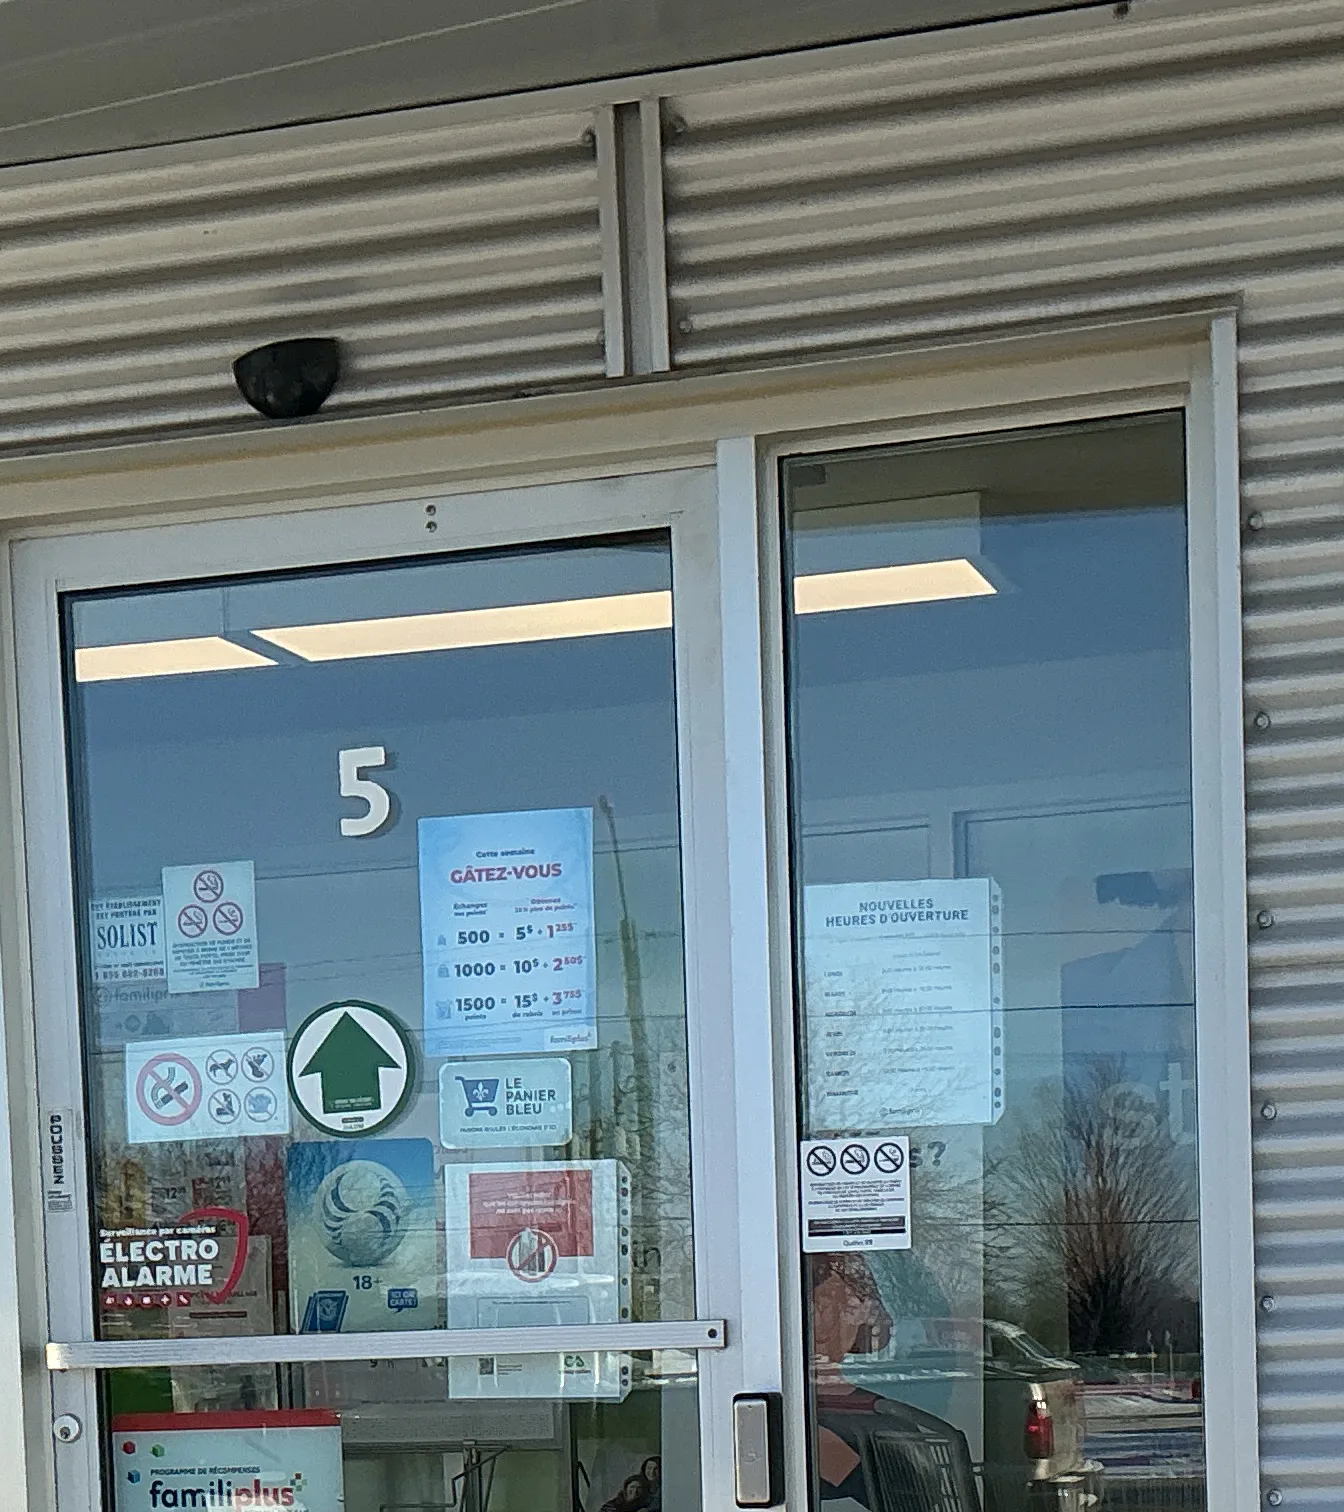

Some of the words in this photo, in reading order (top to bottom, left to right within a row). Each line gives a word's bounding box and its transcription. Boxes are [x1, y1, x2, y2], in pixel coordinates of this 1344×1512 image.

[337, 746, 391, 837] 5
[450, 862, 562, 884] GÂTEZ-VOUS
[859, 898, 934, 912] NOUVELLES
[825, 914, 876, 927] HEURES
[879, 908, 969, 924] D'OUVERTURE
[97, 921, 158, 950] SOLIST
[457, 930, 490, 945] 500
[455, 962, 496, 978] 1000
[455, 996, 496, 1012] 1500
[505, 1077, 522, 1089] LE
[505, 1089, 556, 1103] PANIER
[505, 1103, 542, 1116] BLEU
[99, 1226, 158, 1238] Surveillance
[159, 1227, 174, 1237] par
[175, 1224, 217, 1235] caméras
[99, 1237, 219, 1264] ÉLECTRO
[101, 1263, 213, 1288] ALARME
[352, 1275, 382, 1290] 18+
[150, 1467, 197, 1476] PROGRAMME
[197, 1467, 208, 1475] DE
[208, 1466, 261, 1475] RÉCOMPENSES
